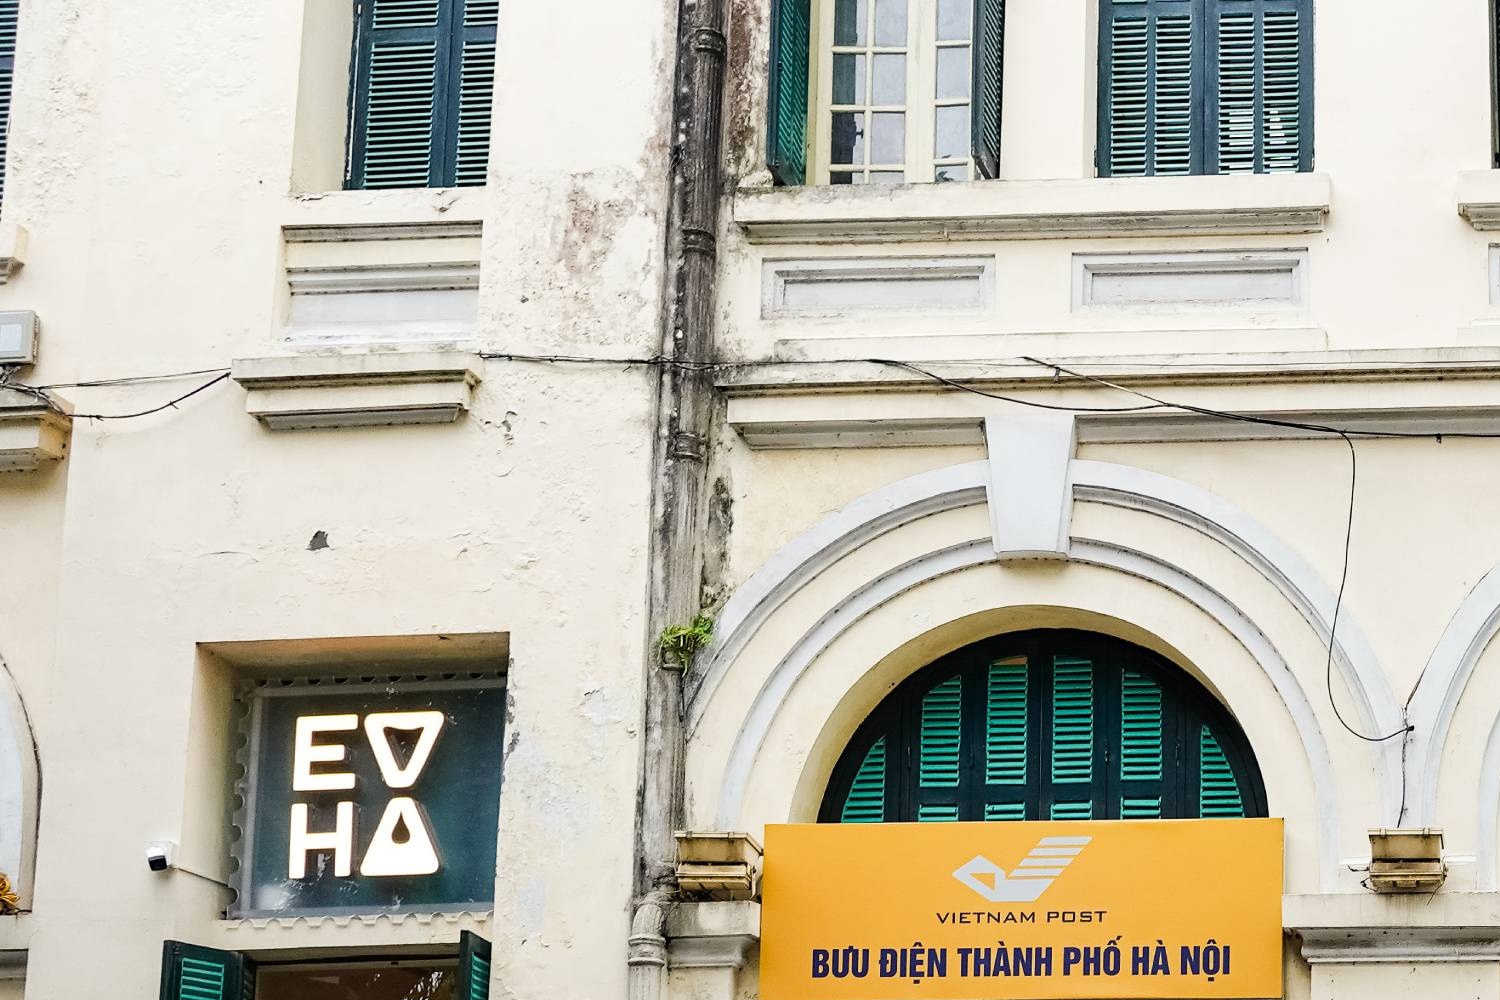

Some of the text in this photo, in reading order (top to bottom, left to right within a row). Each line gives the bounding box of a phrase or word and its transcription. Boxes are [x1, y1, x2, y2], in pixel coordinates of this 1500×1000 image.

[293, 711, 445, 791] EV
[288, 797, 440, 879] HA
[936, 910, 1108, 924] VIETNAM POST
[811, 935, 1231, 985] BƯU ĐIỆN THÀNH PHỐ HÀ NỘI
